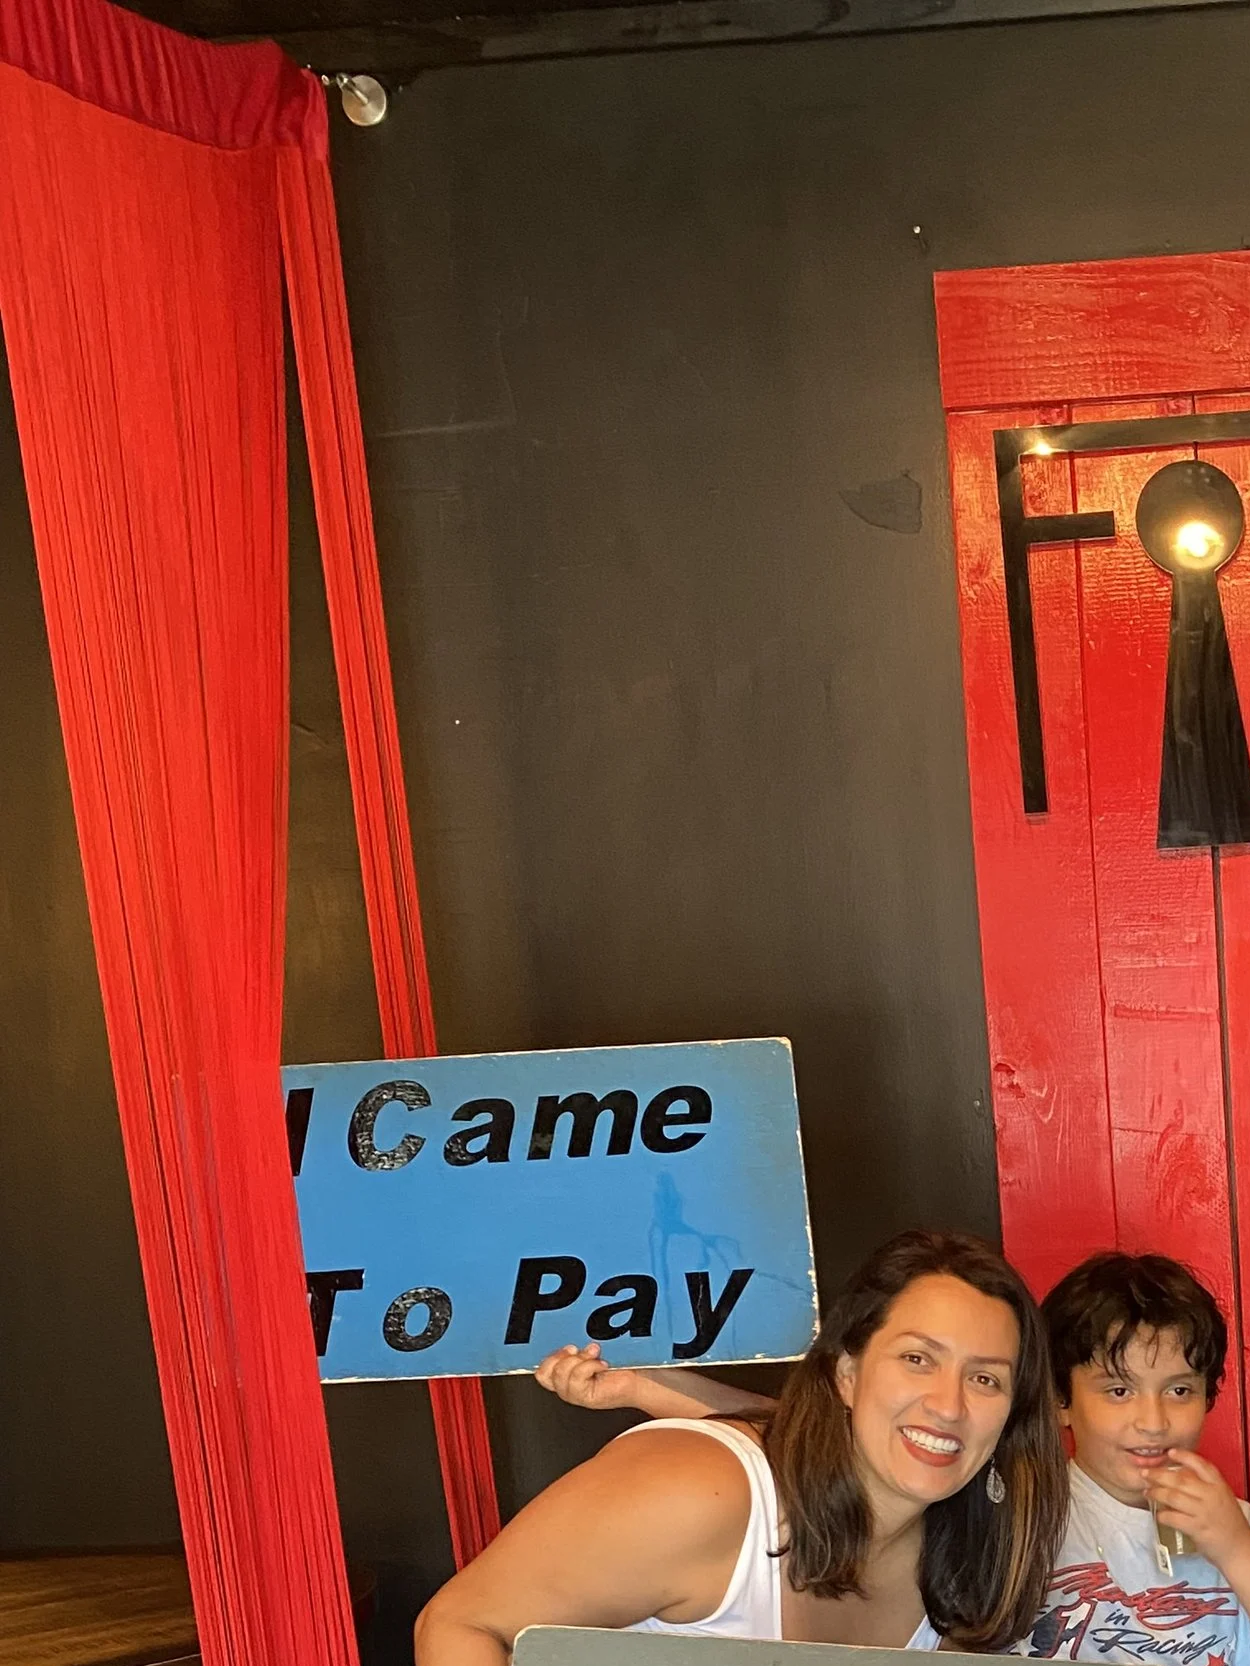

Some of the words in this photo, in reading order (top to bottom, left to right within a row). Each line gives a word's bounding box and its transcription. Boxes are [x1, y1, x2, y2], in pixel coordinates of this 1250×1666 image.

[285, 1087, 314, 1177] I
[347, 1080, 713, 1172] Came
[305, 1268, 453, 1358] To
[503, 1255, 755, 1360] Pay
[1089, 1628, 1228, 1665] Racing
[1103, 1608, 1131, 1626] in
